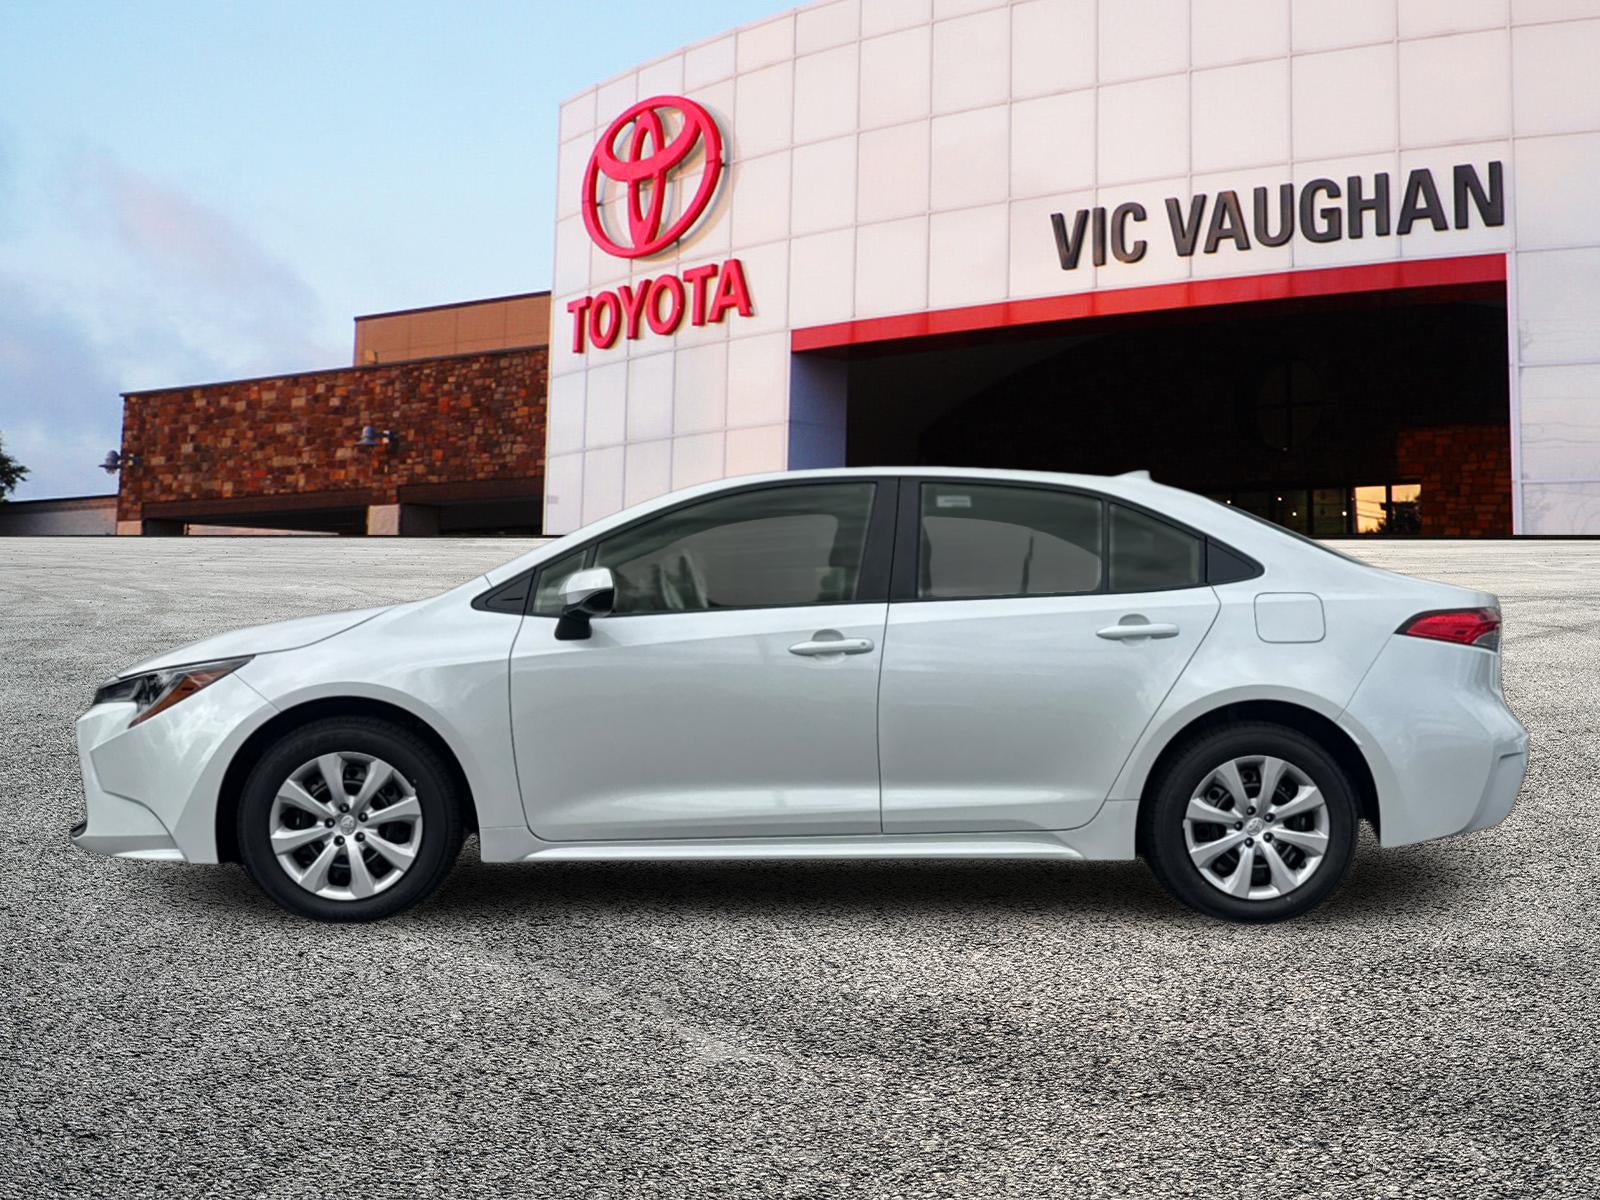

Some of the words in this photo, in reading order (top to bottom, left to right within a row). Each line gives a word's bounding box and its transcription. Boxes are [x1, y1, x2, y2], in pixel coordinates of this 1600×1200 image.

[1051, 202, 1147, 270] VIC
[1165, 160, 1504, 257] VAUGHAN
[567, 259, 752, 353] TOYOTA
